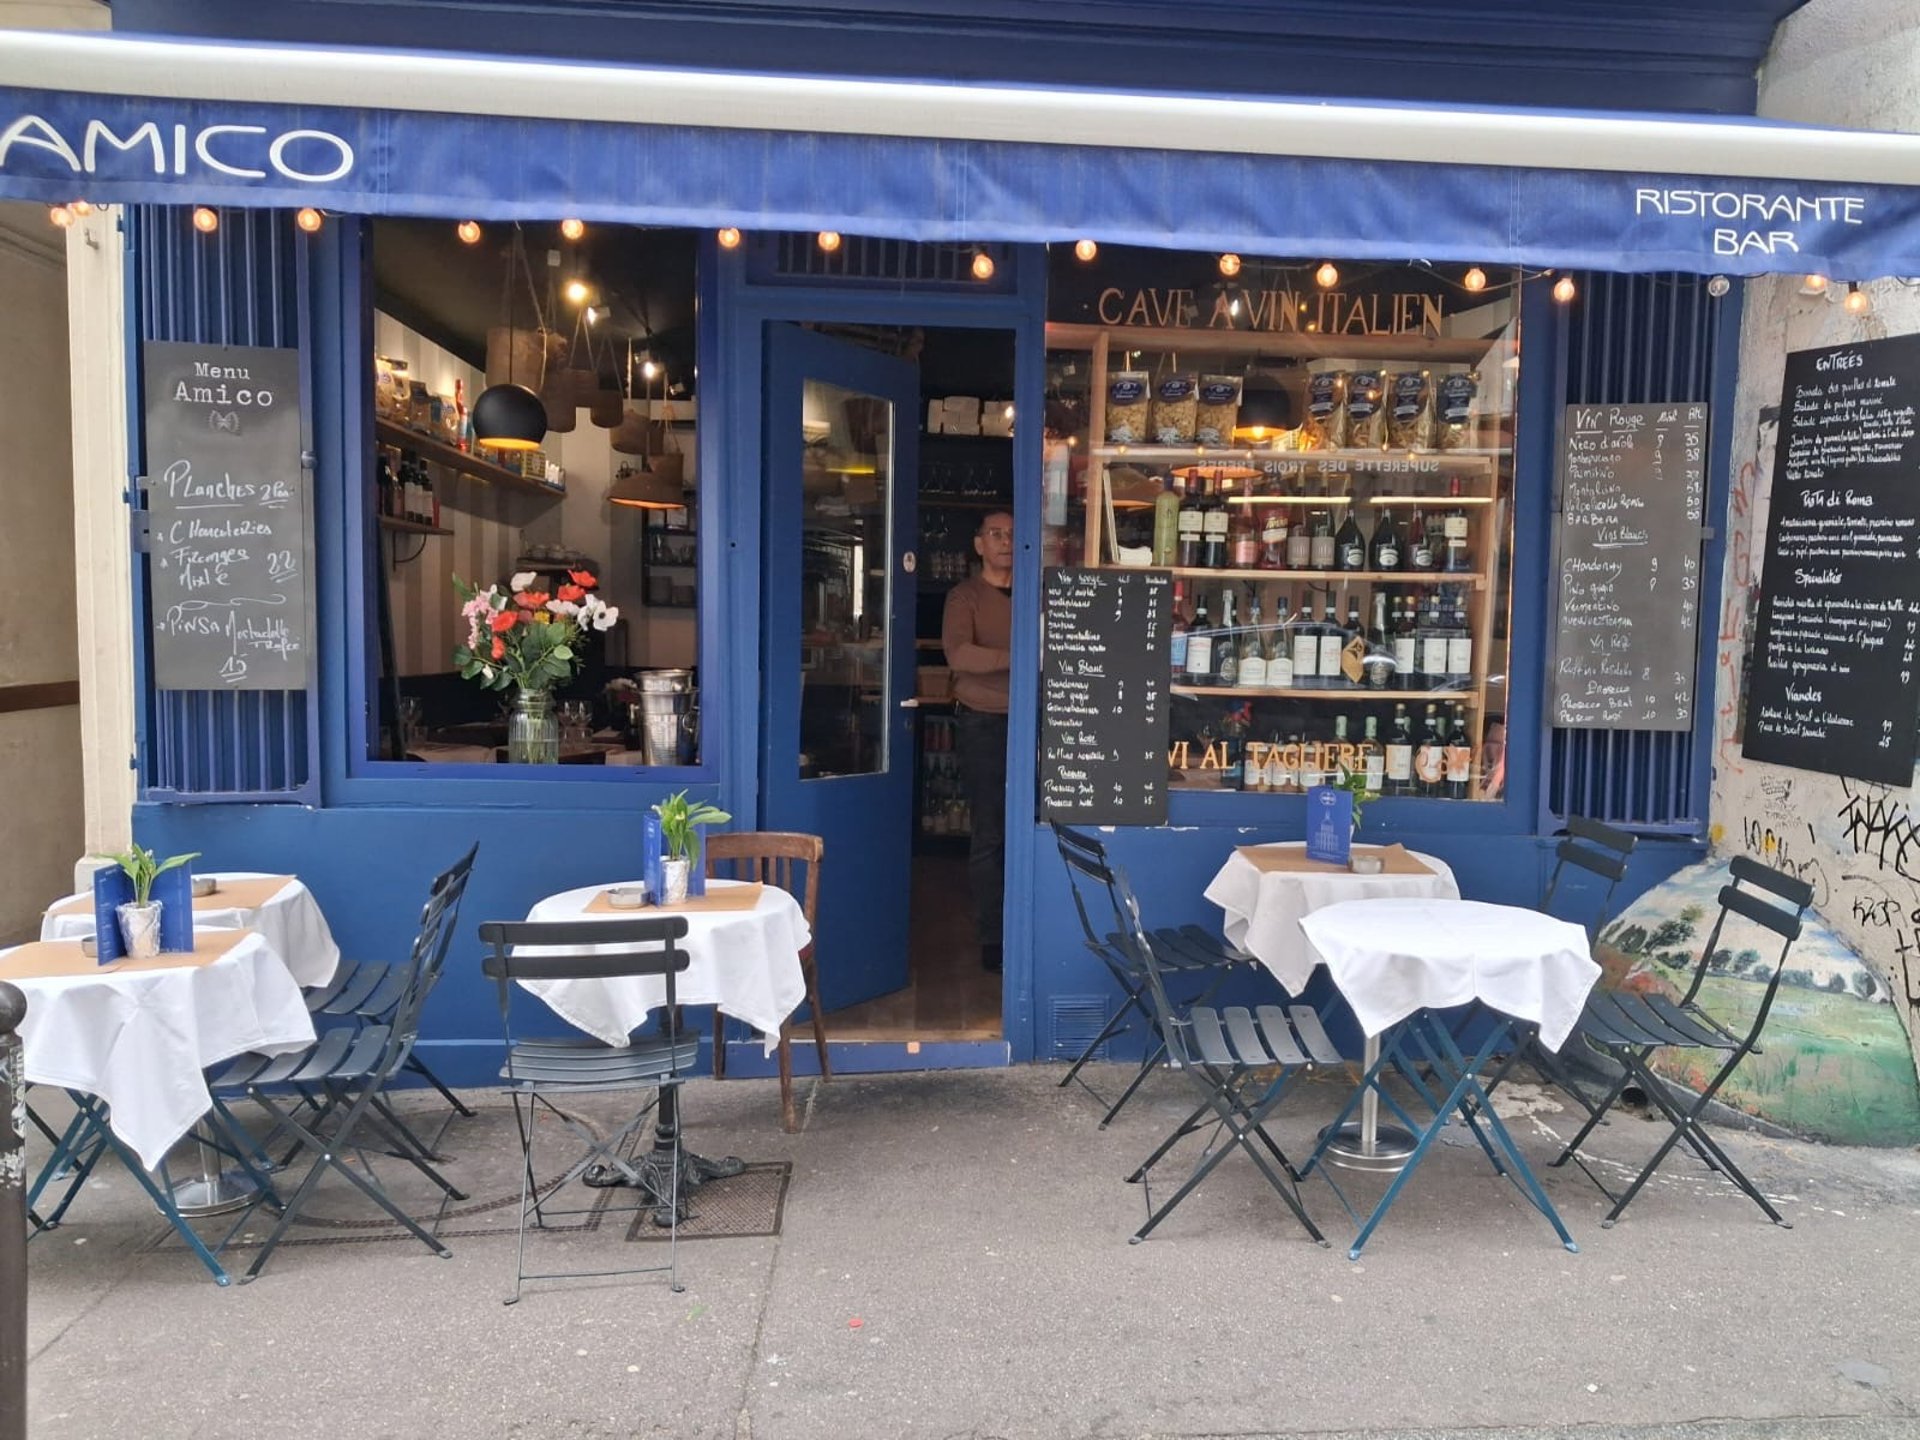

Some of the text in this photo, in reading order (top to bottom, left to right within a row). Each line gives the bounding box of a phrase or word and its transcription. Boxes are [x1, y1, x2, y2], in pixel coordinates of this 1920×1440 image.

[0, 115, 354, 182] AMICO
[1636, 189, 1864, 224] RISTORANTE
[1714, 228, 1799, 255] BAR
[1099, 287, 1193, 328] CAVE
[1241, 290, 1299, 332] VIN
[1317, 293, 1443, 336] ITALIEN
[194, 362, 250, 380] Menu
[173, 381, 273, 407] Amico
[1845, 489, 1873, 507] Roma
[1785, 682, 1822, 702] Viandes
[1200, 742, 1236, 770] AL
